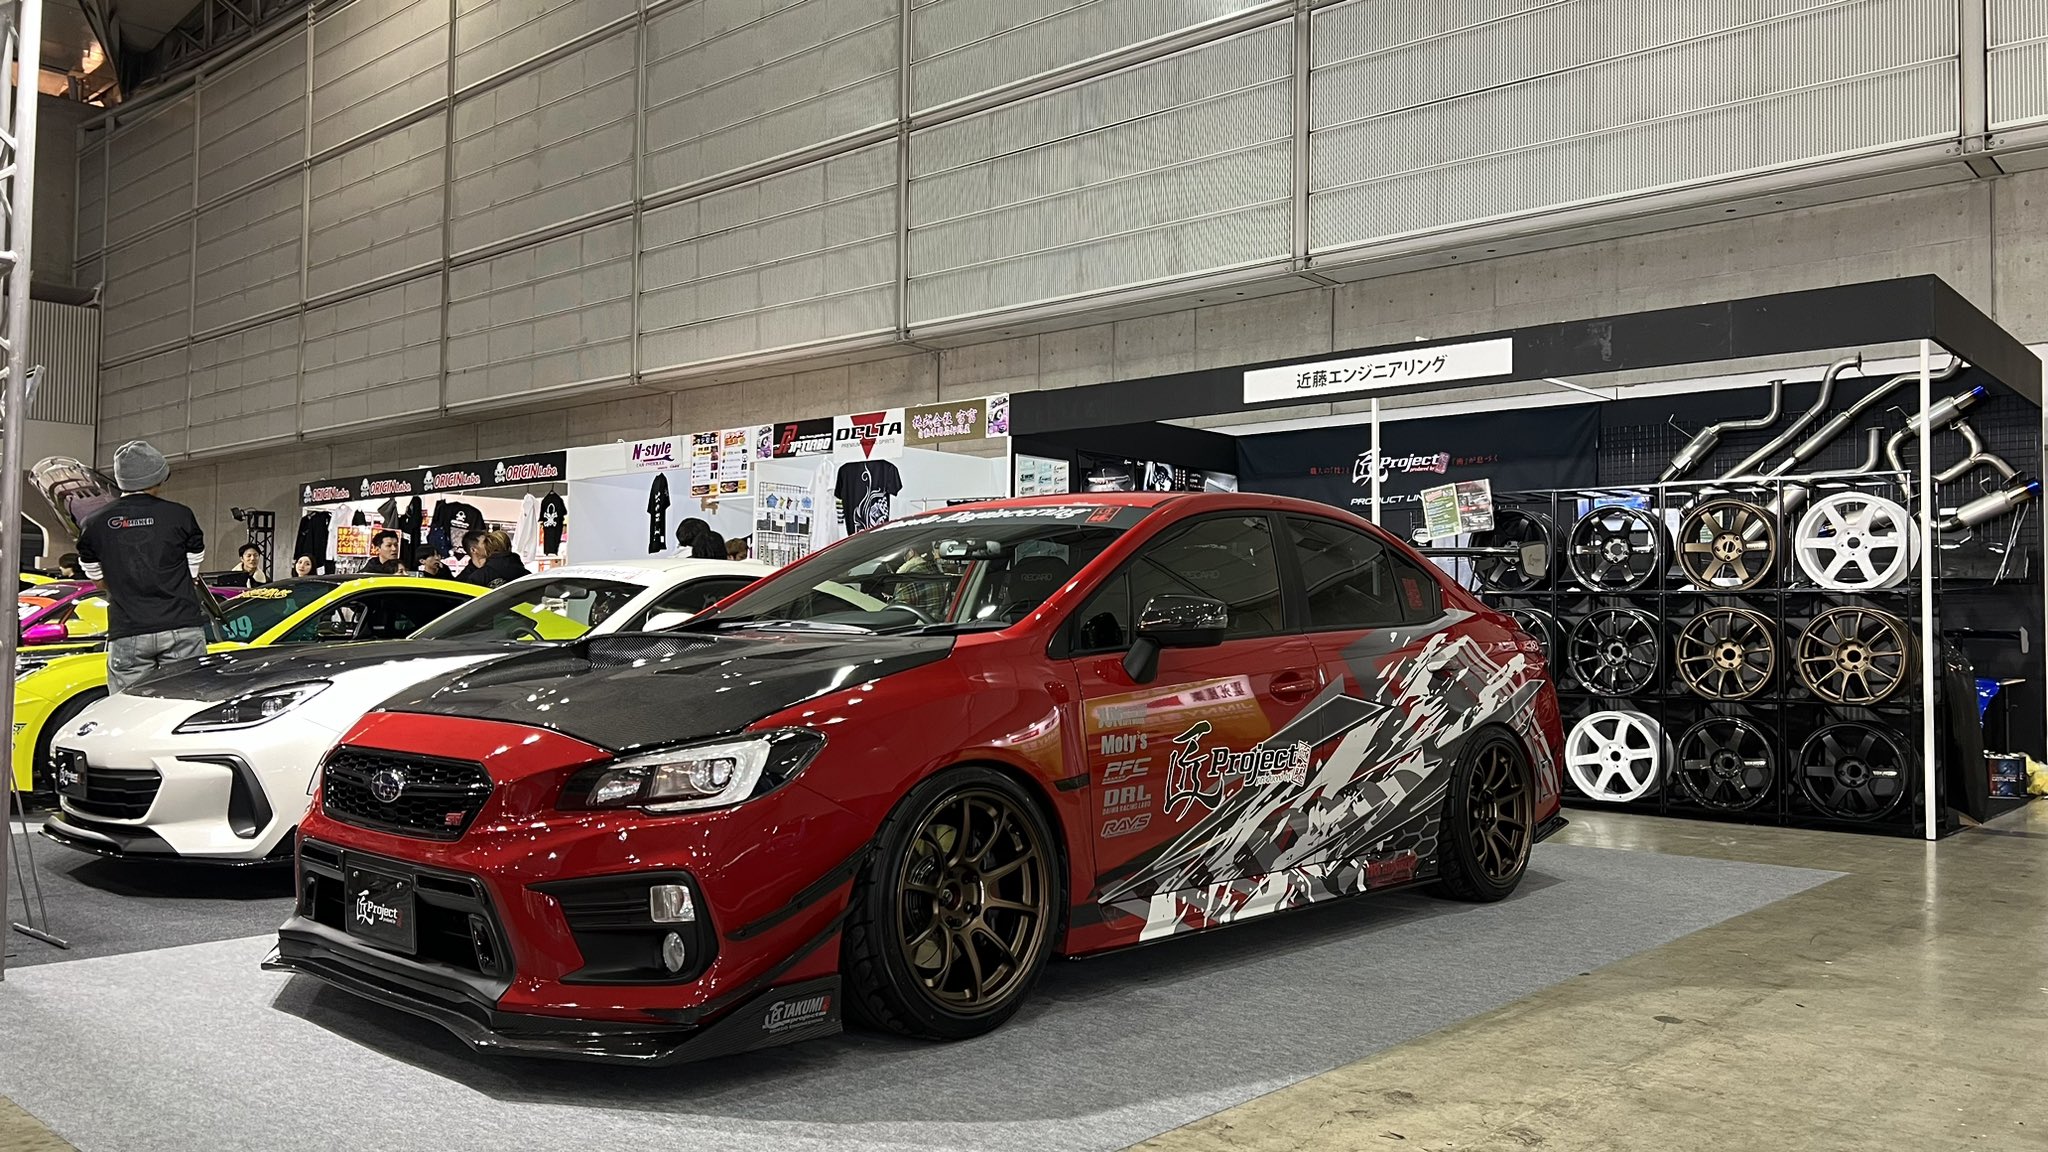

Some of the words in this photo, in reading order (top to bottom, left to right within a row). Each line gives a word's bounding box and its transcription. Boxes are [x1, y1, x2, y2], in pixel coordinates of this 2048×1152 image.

[1296, 356, 1448, 389] 近藤エンジニアリング
[836, 421, 902, 441] DELTA
[632, 441, 672, 461] N-style
[505, 463, 539, 481] ORIGIN
[1379, 453, 1440, 473] Project
[370, 480, 396, 496] ORIGIN
[434, 471, 465, 489] ORIGIN
[313, 487, 336, 502] ORIGIN
[1350, 495, 1403, 506] PROUCT
[1101, 731, 1148, 755] Moty's
[1206, 742, 1299, 787] Project
[1103, 784, 1152, 808] DRL
[1101, 813, 1152, 839] RAYS
[367, 900, 398, 921] Project
[783, 996, 825, 1019] TAKUMI
